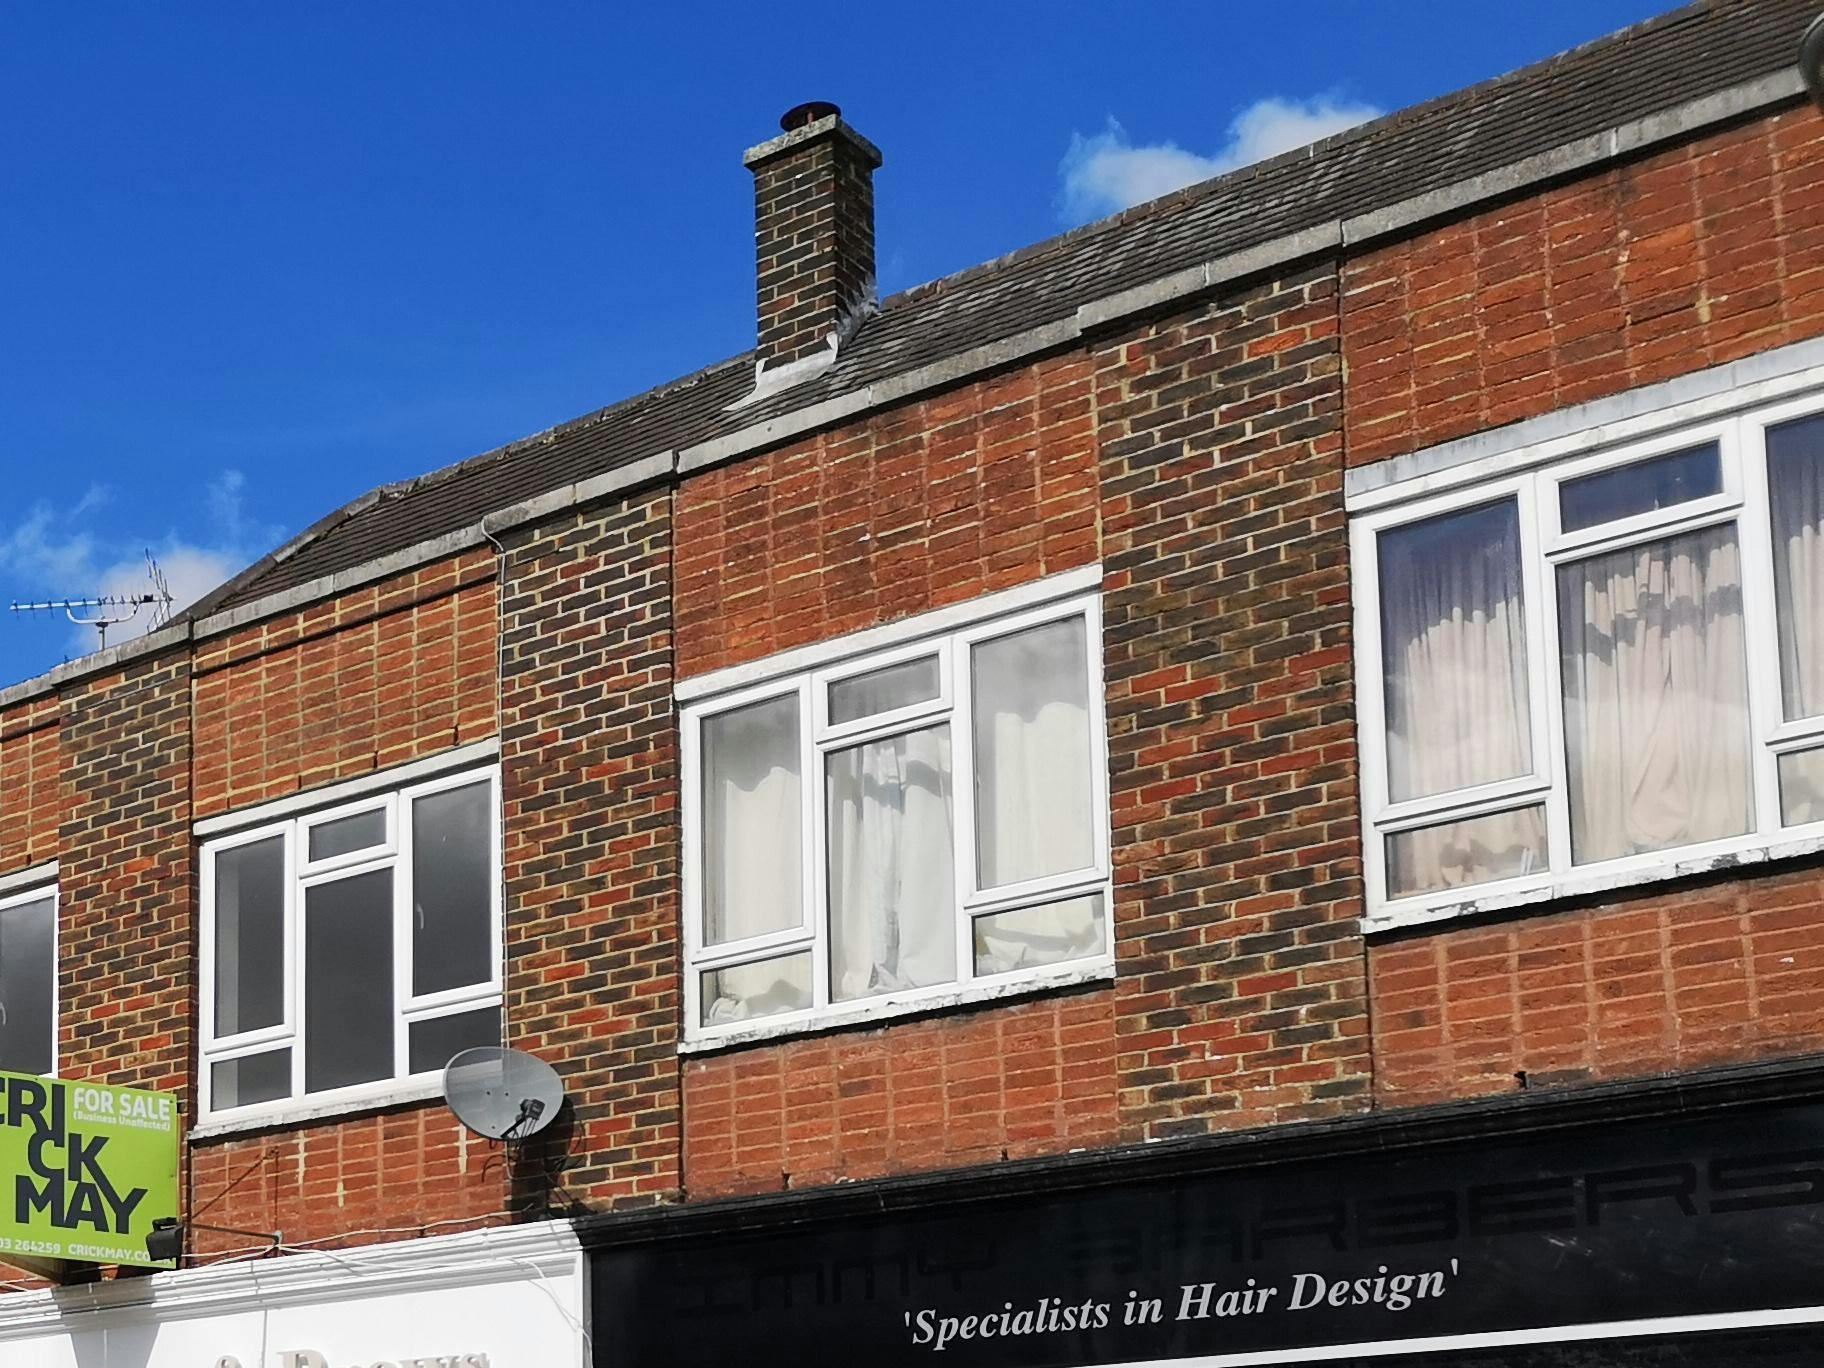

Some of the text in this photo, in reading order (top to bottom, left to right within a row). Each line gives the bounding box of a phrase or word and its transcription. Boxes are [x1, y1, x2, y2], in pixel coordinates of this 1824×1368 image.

[73, 1087, 170, 1121] FOR SALE
[15, 1173, 148, 1235] MAY
[15, 1238, 61, 1254] 264259
[904, 1258, 1459, 1351] 'Specialists in Hair Design'
